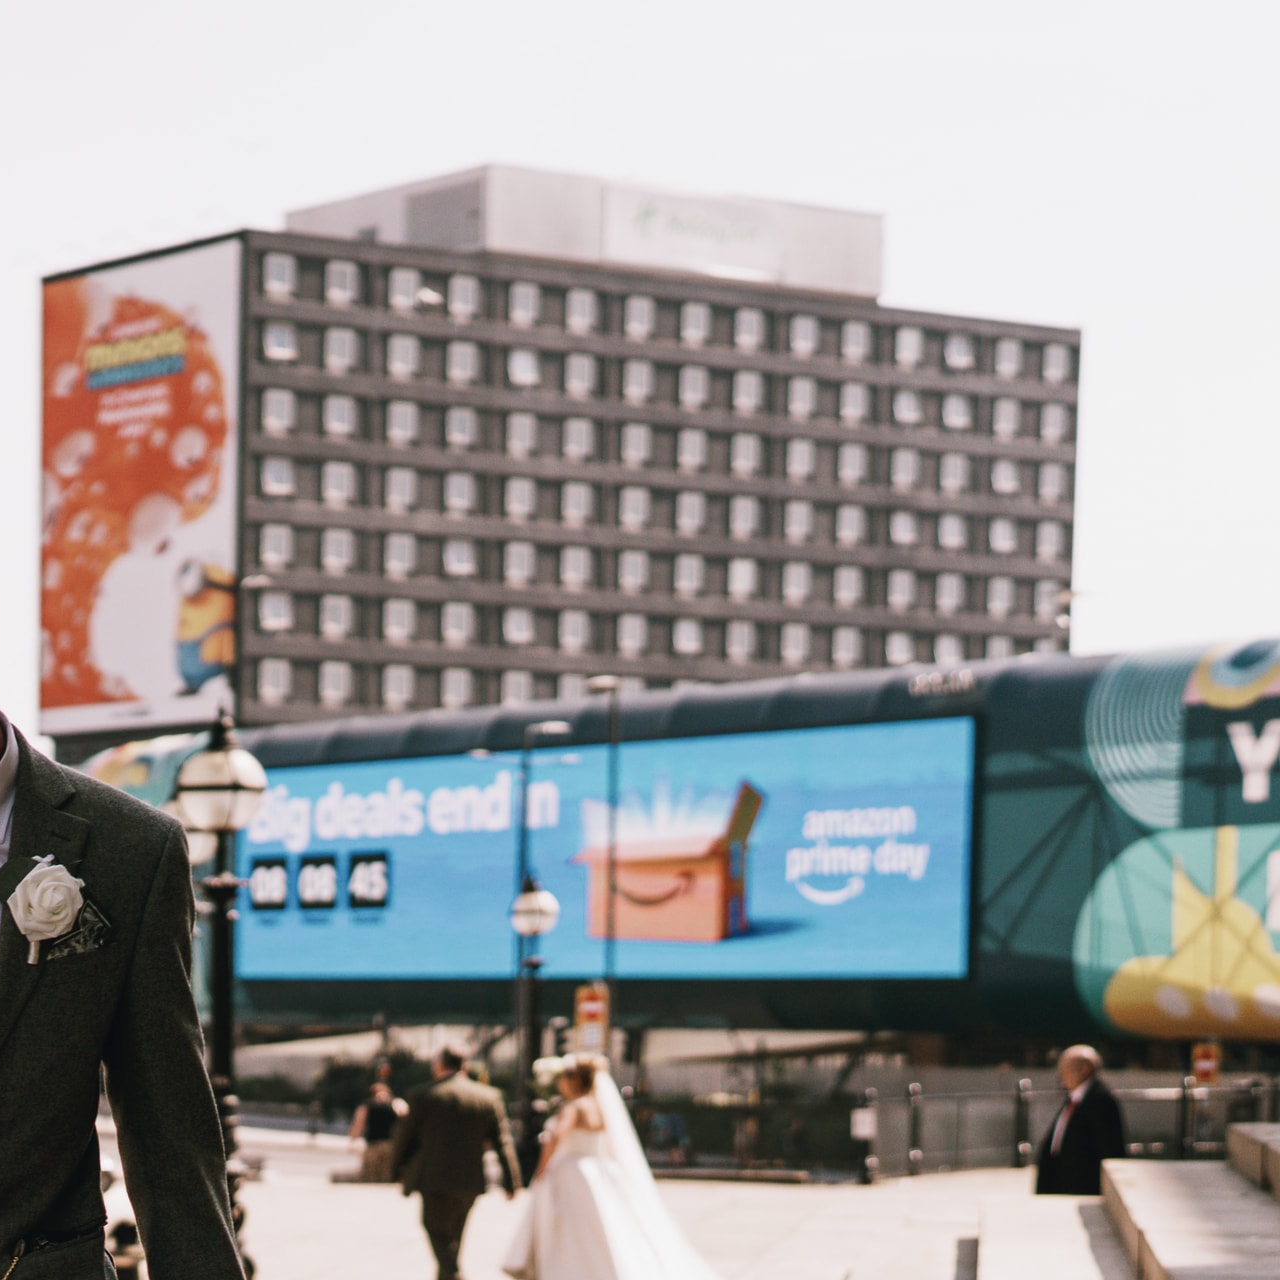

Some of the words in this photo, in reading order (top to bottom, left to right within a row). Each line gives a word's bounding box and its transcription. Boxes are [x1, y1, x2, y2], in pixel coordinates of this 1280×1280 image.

[315, 777, 424, 840] deals
[427, 770, 511, 835] end
[516, 777, 559, 830] n
[803, 806, 916, 840] amazon
[786, 838, 872, 882] prime
[874, 838, 930, 880] day
